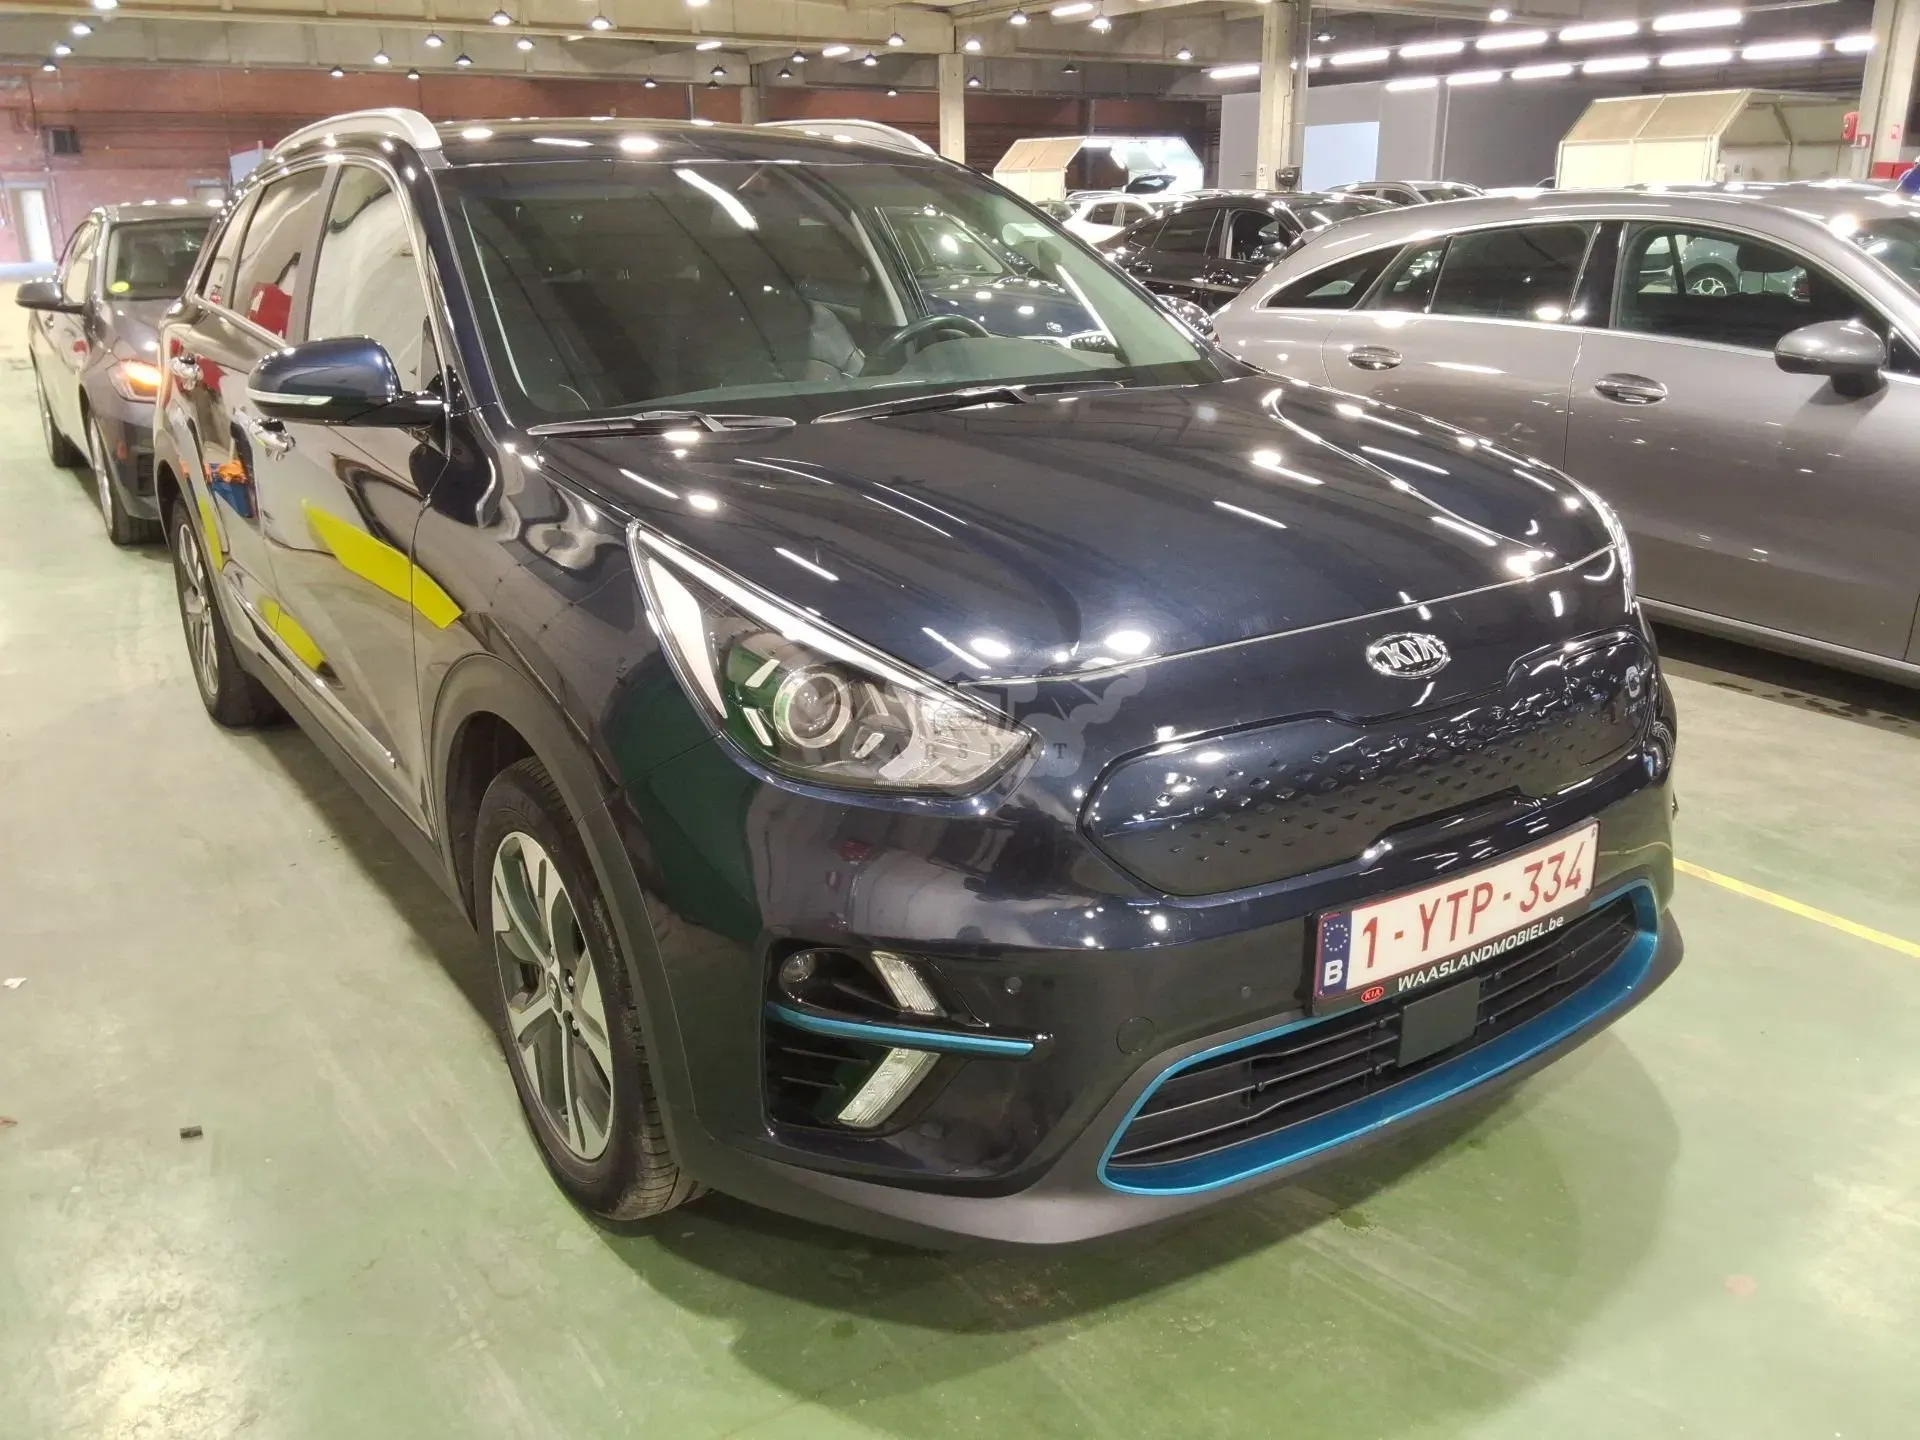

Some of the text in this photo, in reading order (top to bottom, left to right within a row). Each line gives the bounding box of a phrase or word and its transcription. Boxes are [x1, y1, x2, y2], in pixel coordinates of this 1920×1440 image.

[1379, 638, 1441, 669] KIA
[1362, 841, 1586, 968] 1-YTP-334
[1398, 914, 1564, 992] WAASLANDMOBIEL.be
[1323, 959, 1343, 987] B
[1364, 988, 1382, 1001] KIA
